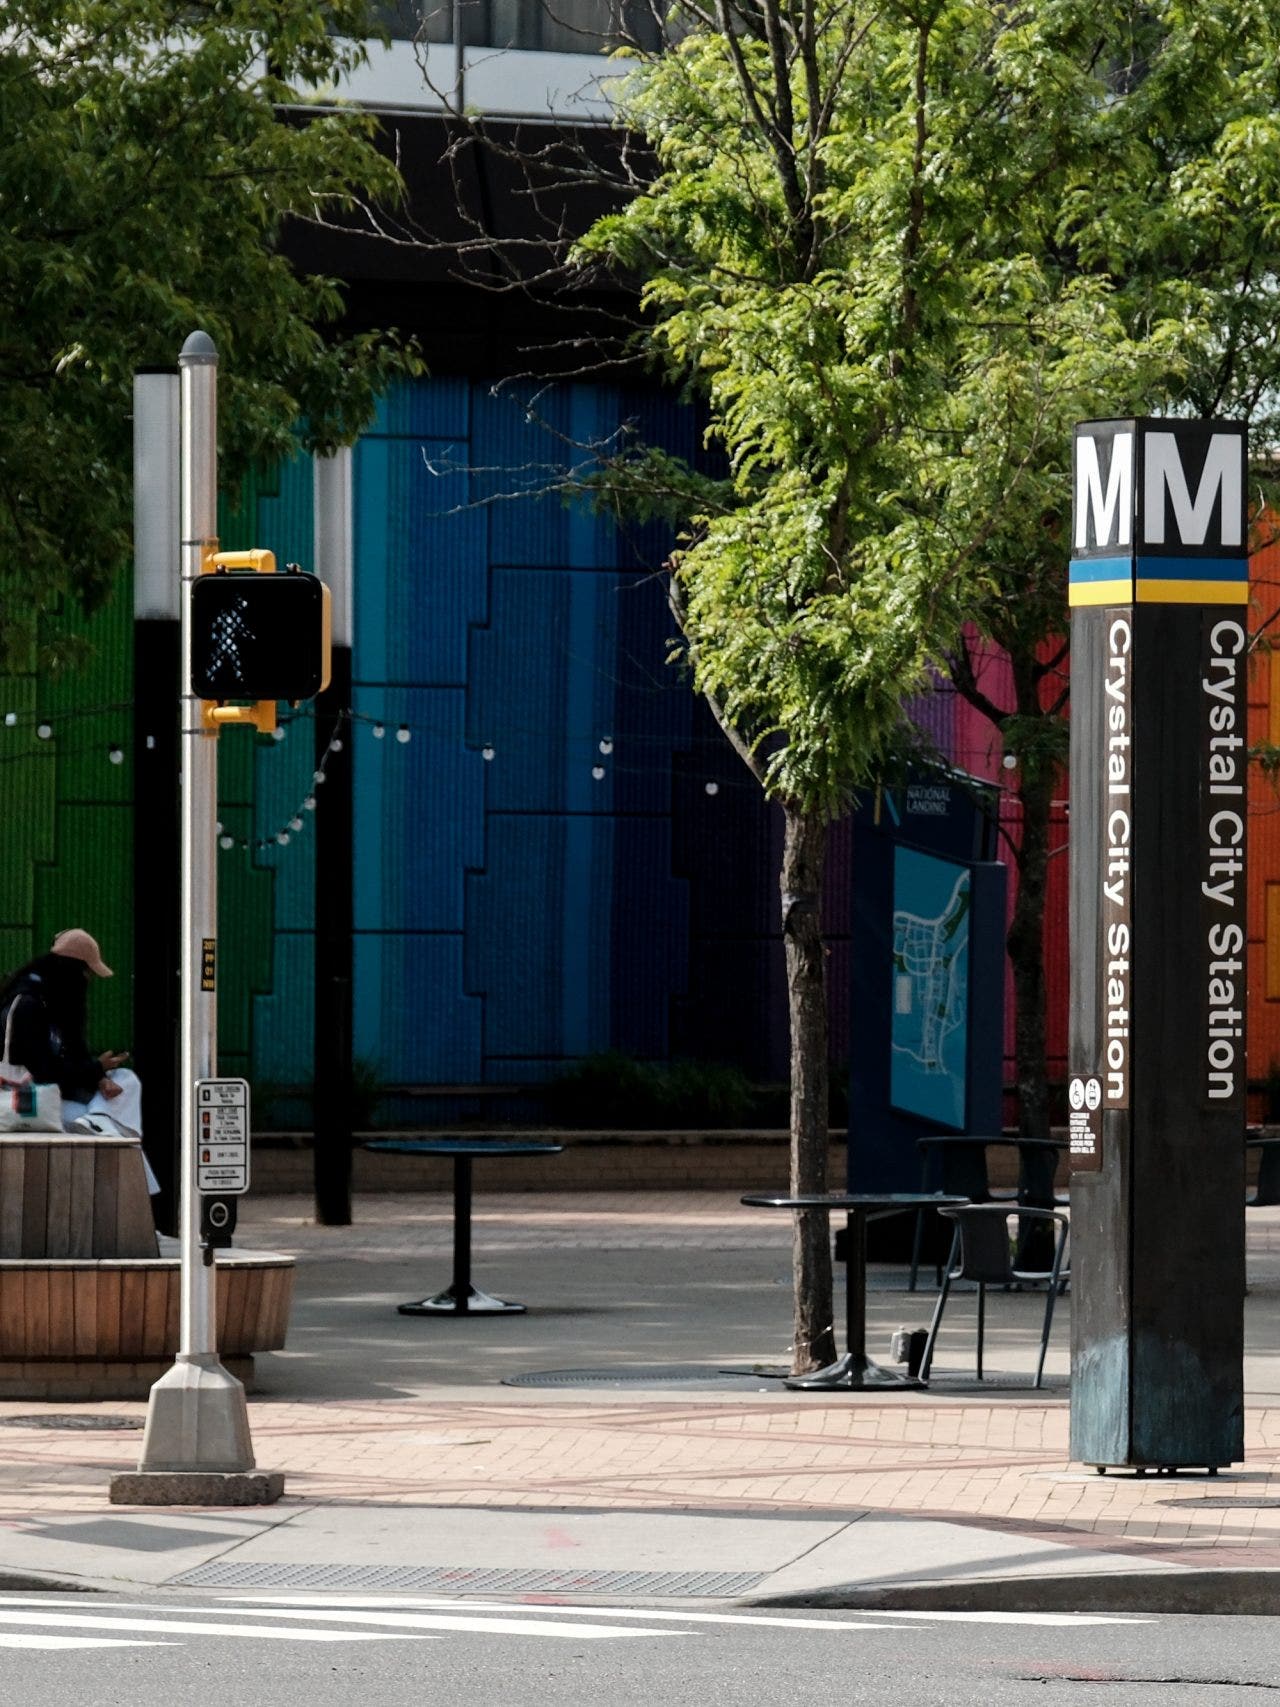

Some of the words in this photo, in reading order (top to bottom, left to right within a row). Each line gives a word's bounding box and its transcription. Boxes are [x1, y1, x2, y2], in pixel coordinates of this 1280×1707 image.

[1076, 432, 1132, 549] M
[1144, 431, 1242, 546] M
[1105, 619, 1132, 795] Crystal
[1202, 620, 1245, 795] Crystal
[906, 788, 951, 801] NATIONAL
[906, 800, 947, 813] LANDING
[1103, 809, 1131, 907] City
[1201, 810, 1244, 907] City
[1107, 923, 1130, 1099] Station
[1208, 923, 1244, 1098] Station
